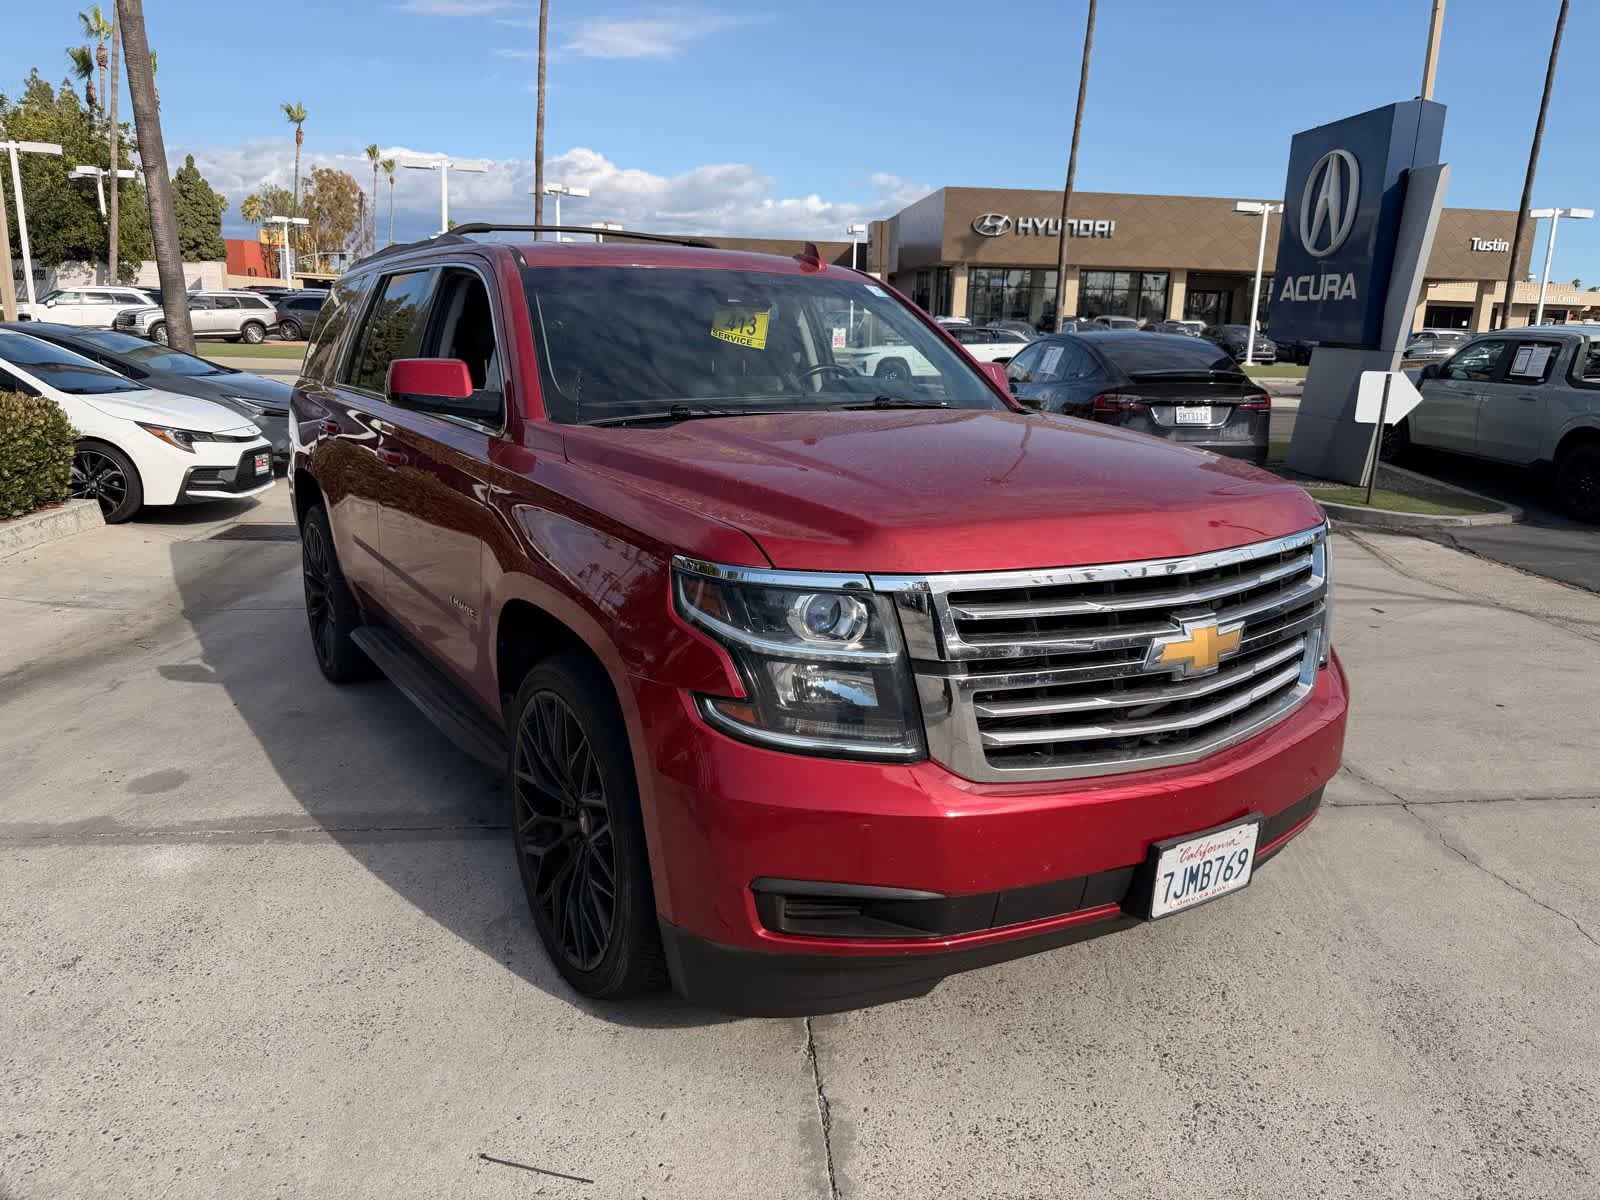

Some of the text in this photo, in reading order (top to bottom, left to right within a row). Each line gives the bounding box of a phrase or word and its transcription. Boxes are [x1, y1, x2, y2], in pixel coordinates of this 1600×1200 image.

[1471, 237, 1509, 252] Tustin
[1280, 272, 1357, 302] ACURA
[712, 329, 753, 346] SERVICE
[1179, 838, 1240, 863] California
[1164, 848, 1249, 904] 7JMB769
